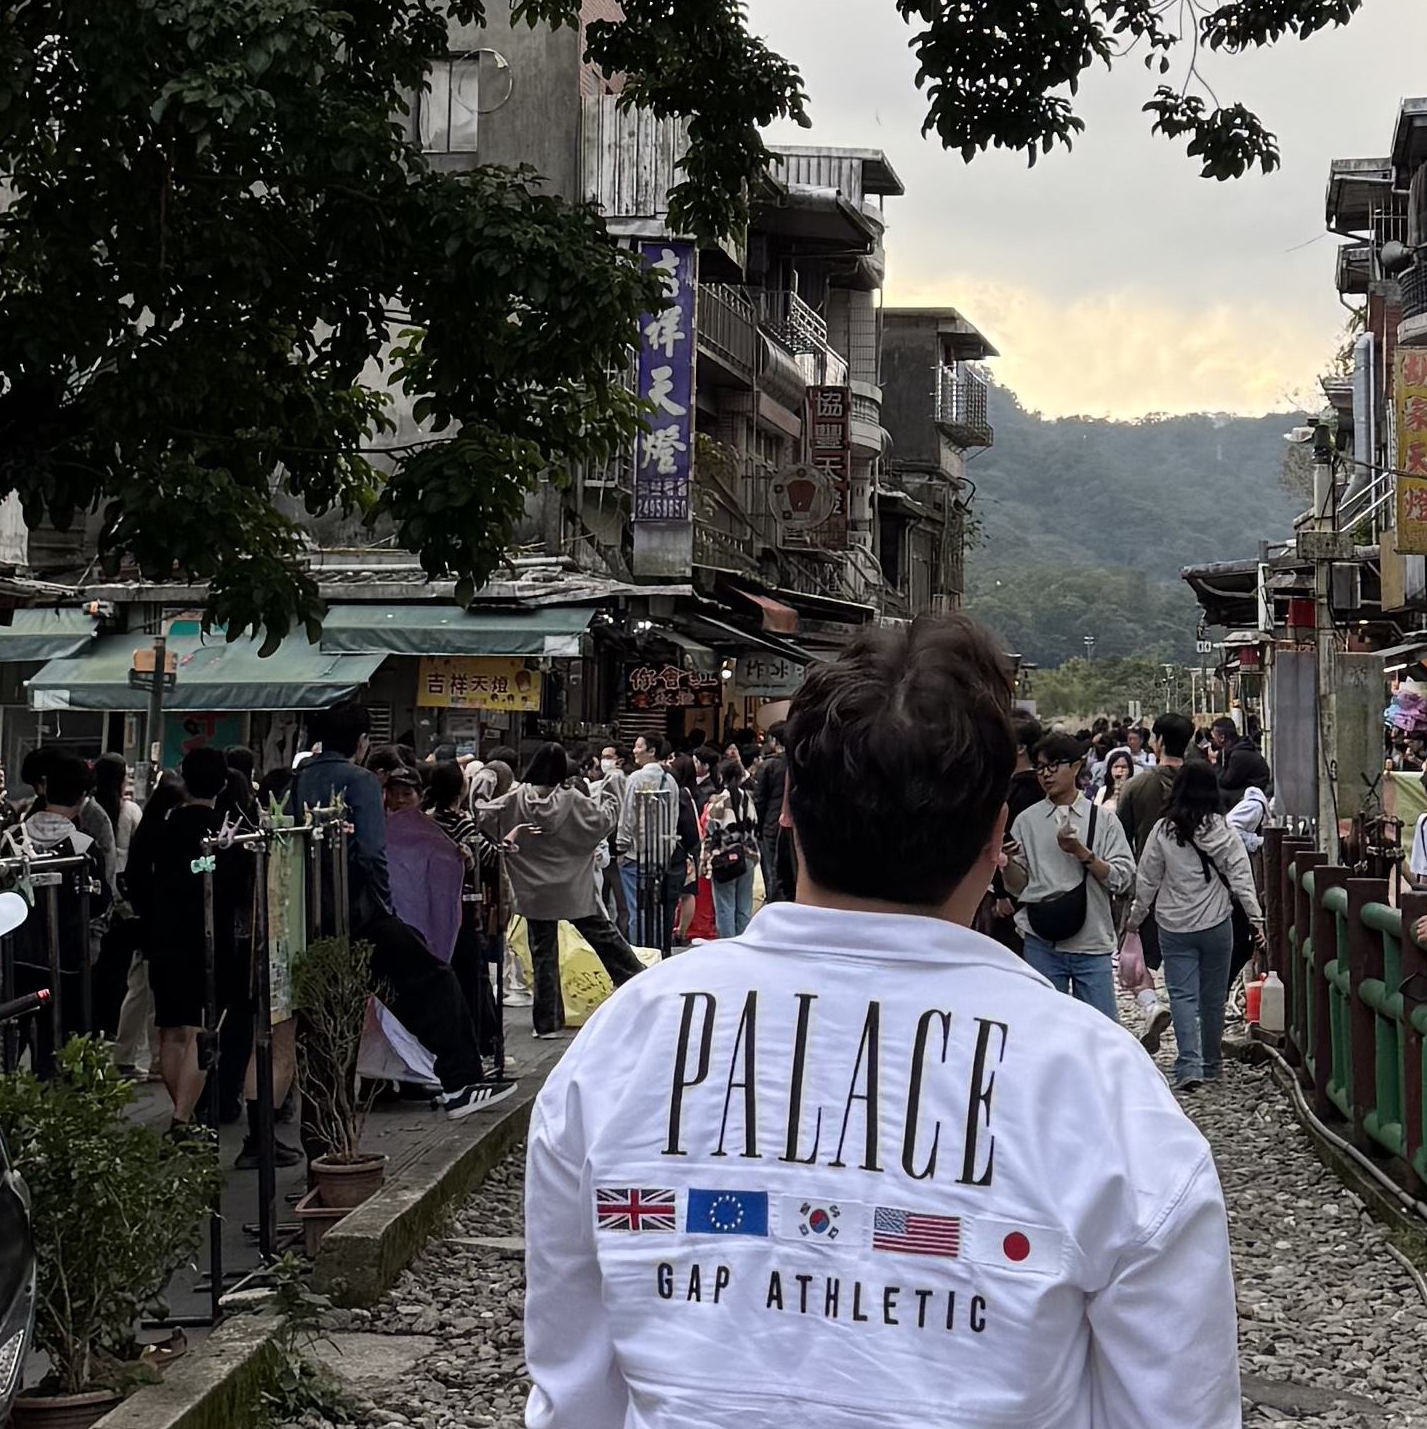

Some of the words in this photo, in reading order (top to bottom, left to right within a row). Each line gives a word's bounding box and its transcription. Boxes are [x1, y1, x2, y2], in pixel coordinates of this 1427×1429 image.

[640, 248, 688, 475] 吉祥天燈
[427, 672, 509, 695] 吉祥天燈
[661, 990, 1009, 1187] PALACE
[657, 1263, 731, 1305] GAP
[767, 1271, 987, 1333] ATHLETIC
